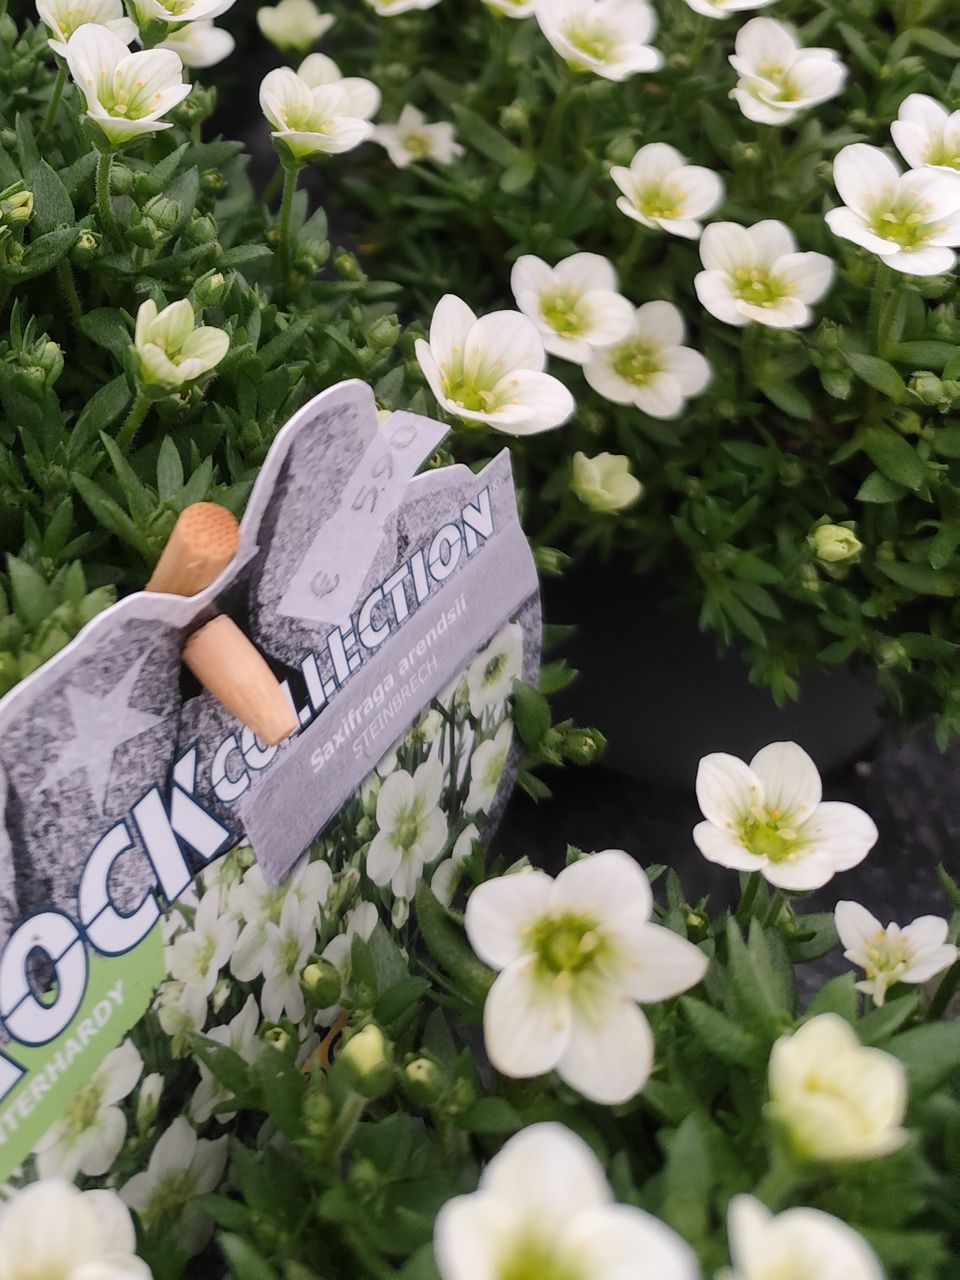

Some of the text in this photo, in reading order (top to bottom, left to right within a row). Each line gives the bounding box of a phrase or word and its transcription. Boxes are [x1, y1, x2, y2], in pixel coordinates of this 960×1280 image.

[310, 424, 419, 600] € 5.90
[309, 593, 468, 774] Saxifraga arendsii
[350, 654, 439, 760] STEINBRECH
